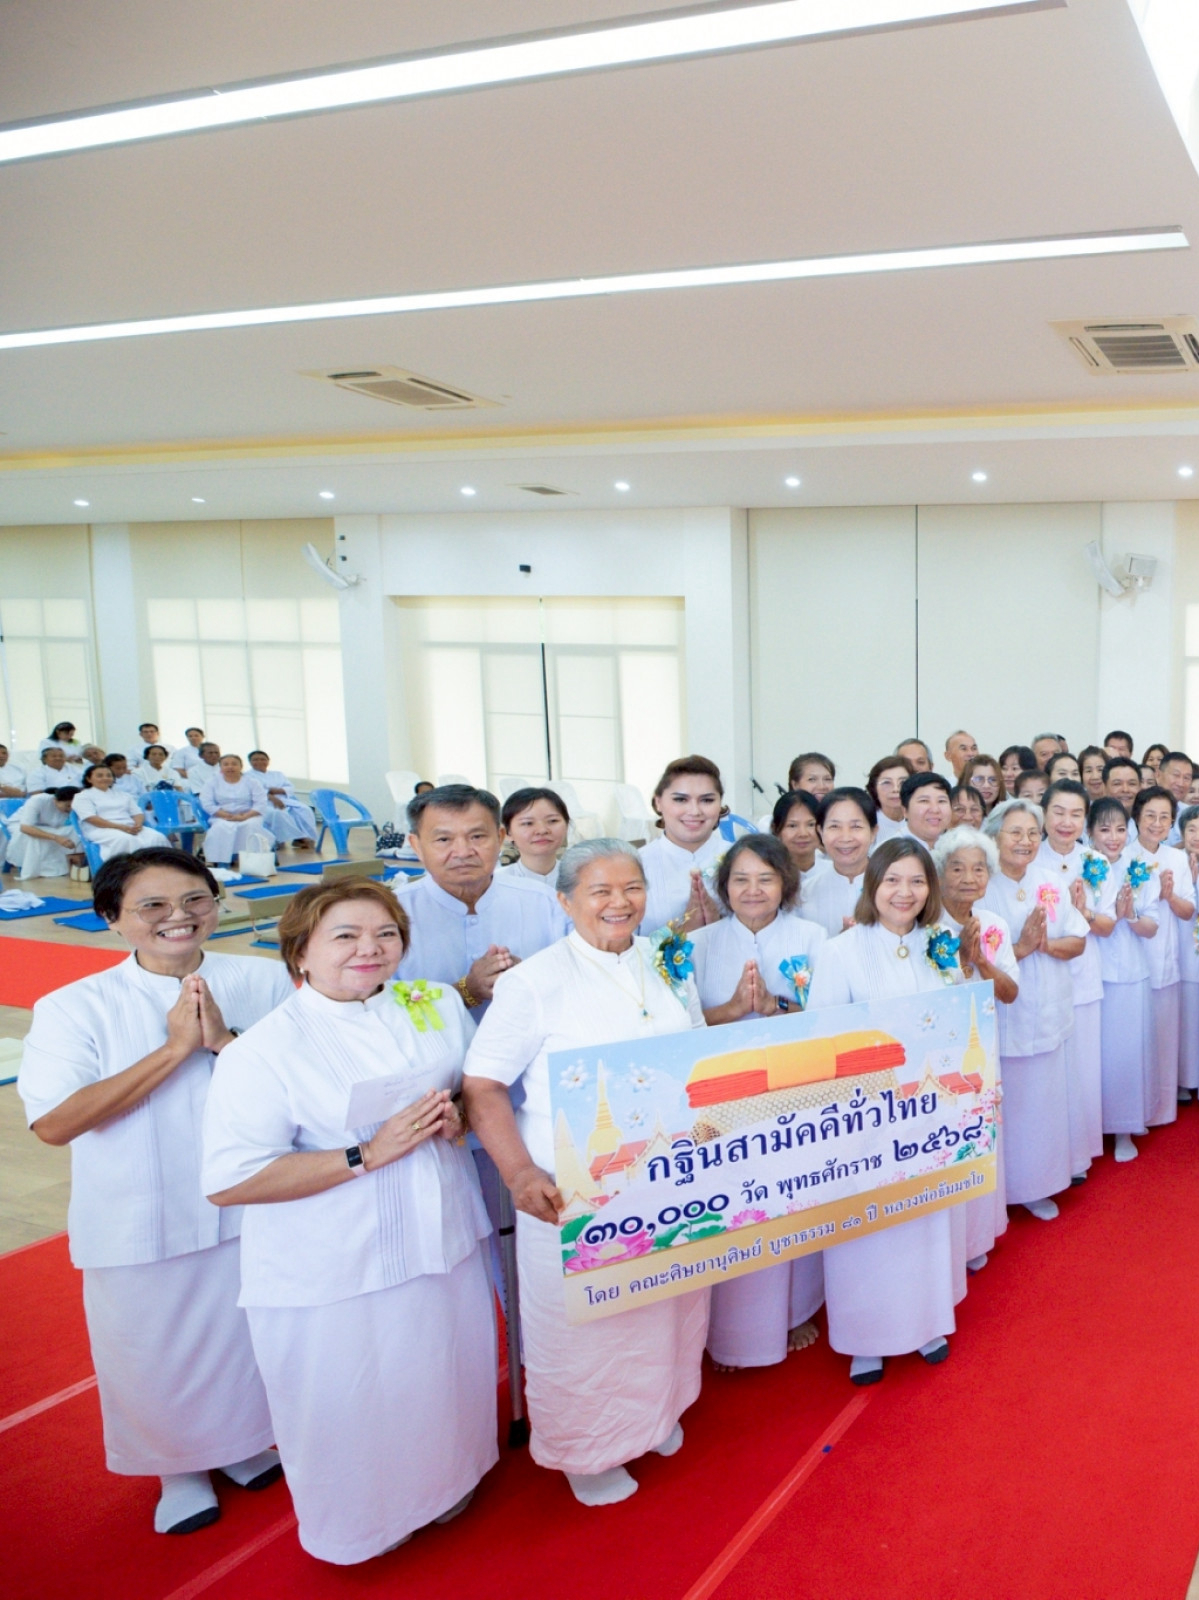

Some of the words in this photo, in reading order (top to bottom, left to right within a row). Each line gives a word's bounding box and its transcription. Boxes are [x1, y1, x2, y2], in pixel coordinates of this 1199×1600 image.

[584, 1193, 730, 1245] ๓๐,๐๐๐
[740, 1178, 769, 1205] วัด
[776, 1153, 883, 1200] พุทธศักราช
[892, 1115, 984, 1162] ๒๕๖๘
[647, 1088, 938, 1186] กฐินสามัคคีทั่วไทย
[584, 1285, 620, 1306] โดย
[629, 1238, 763, 1294] คณะศิษยานุศิษย์
[769, 1220, 835, 1255] บูชาธรรม
[867, 1203, 878, 1222] ปี
[884, 1170, 985, 1216] หลวงพ่อธัมมชโย
